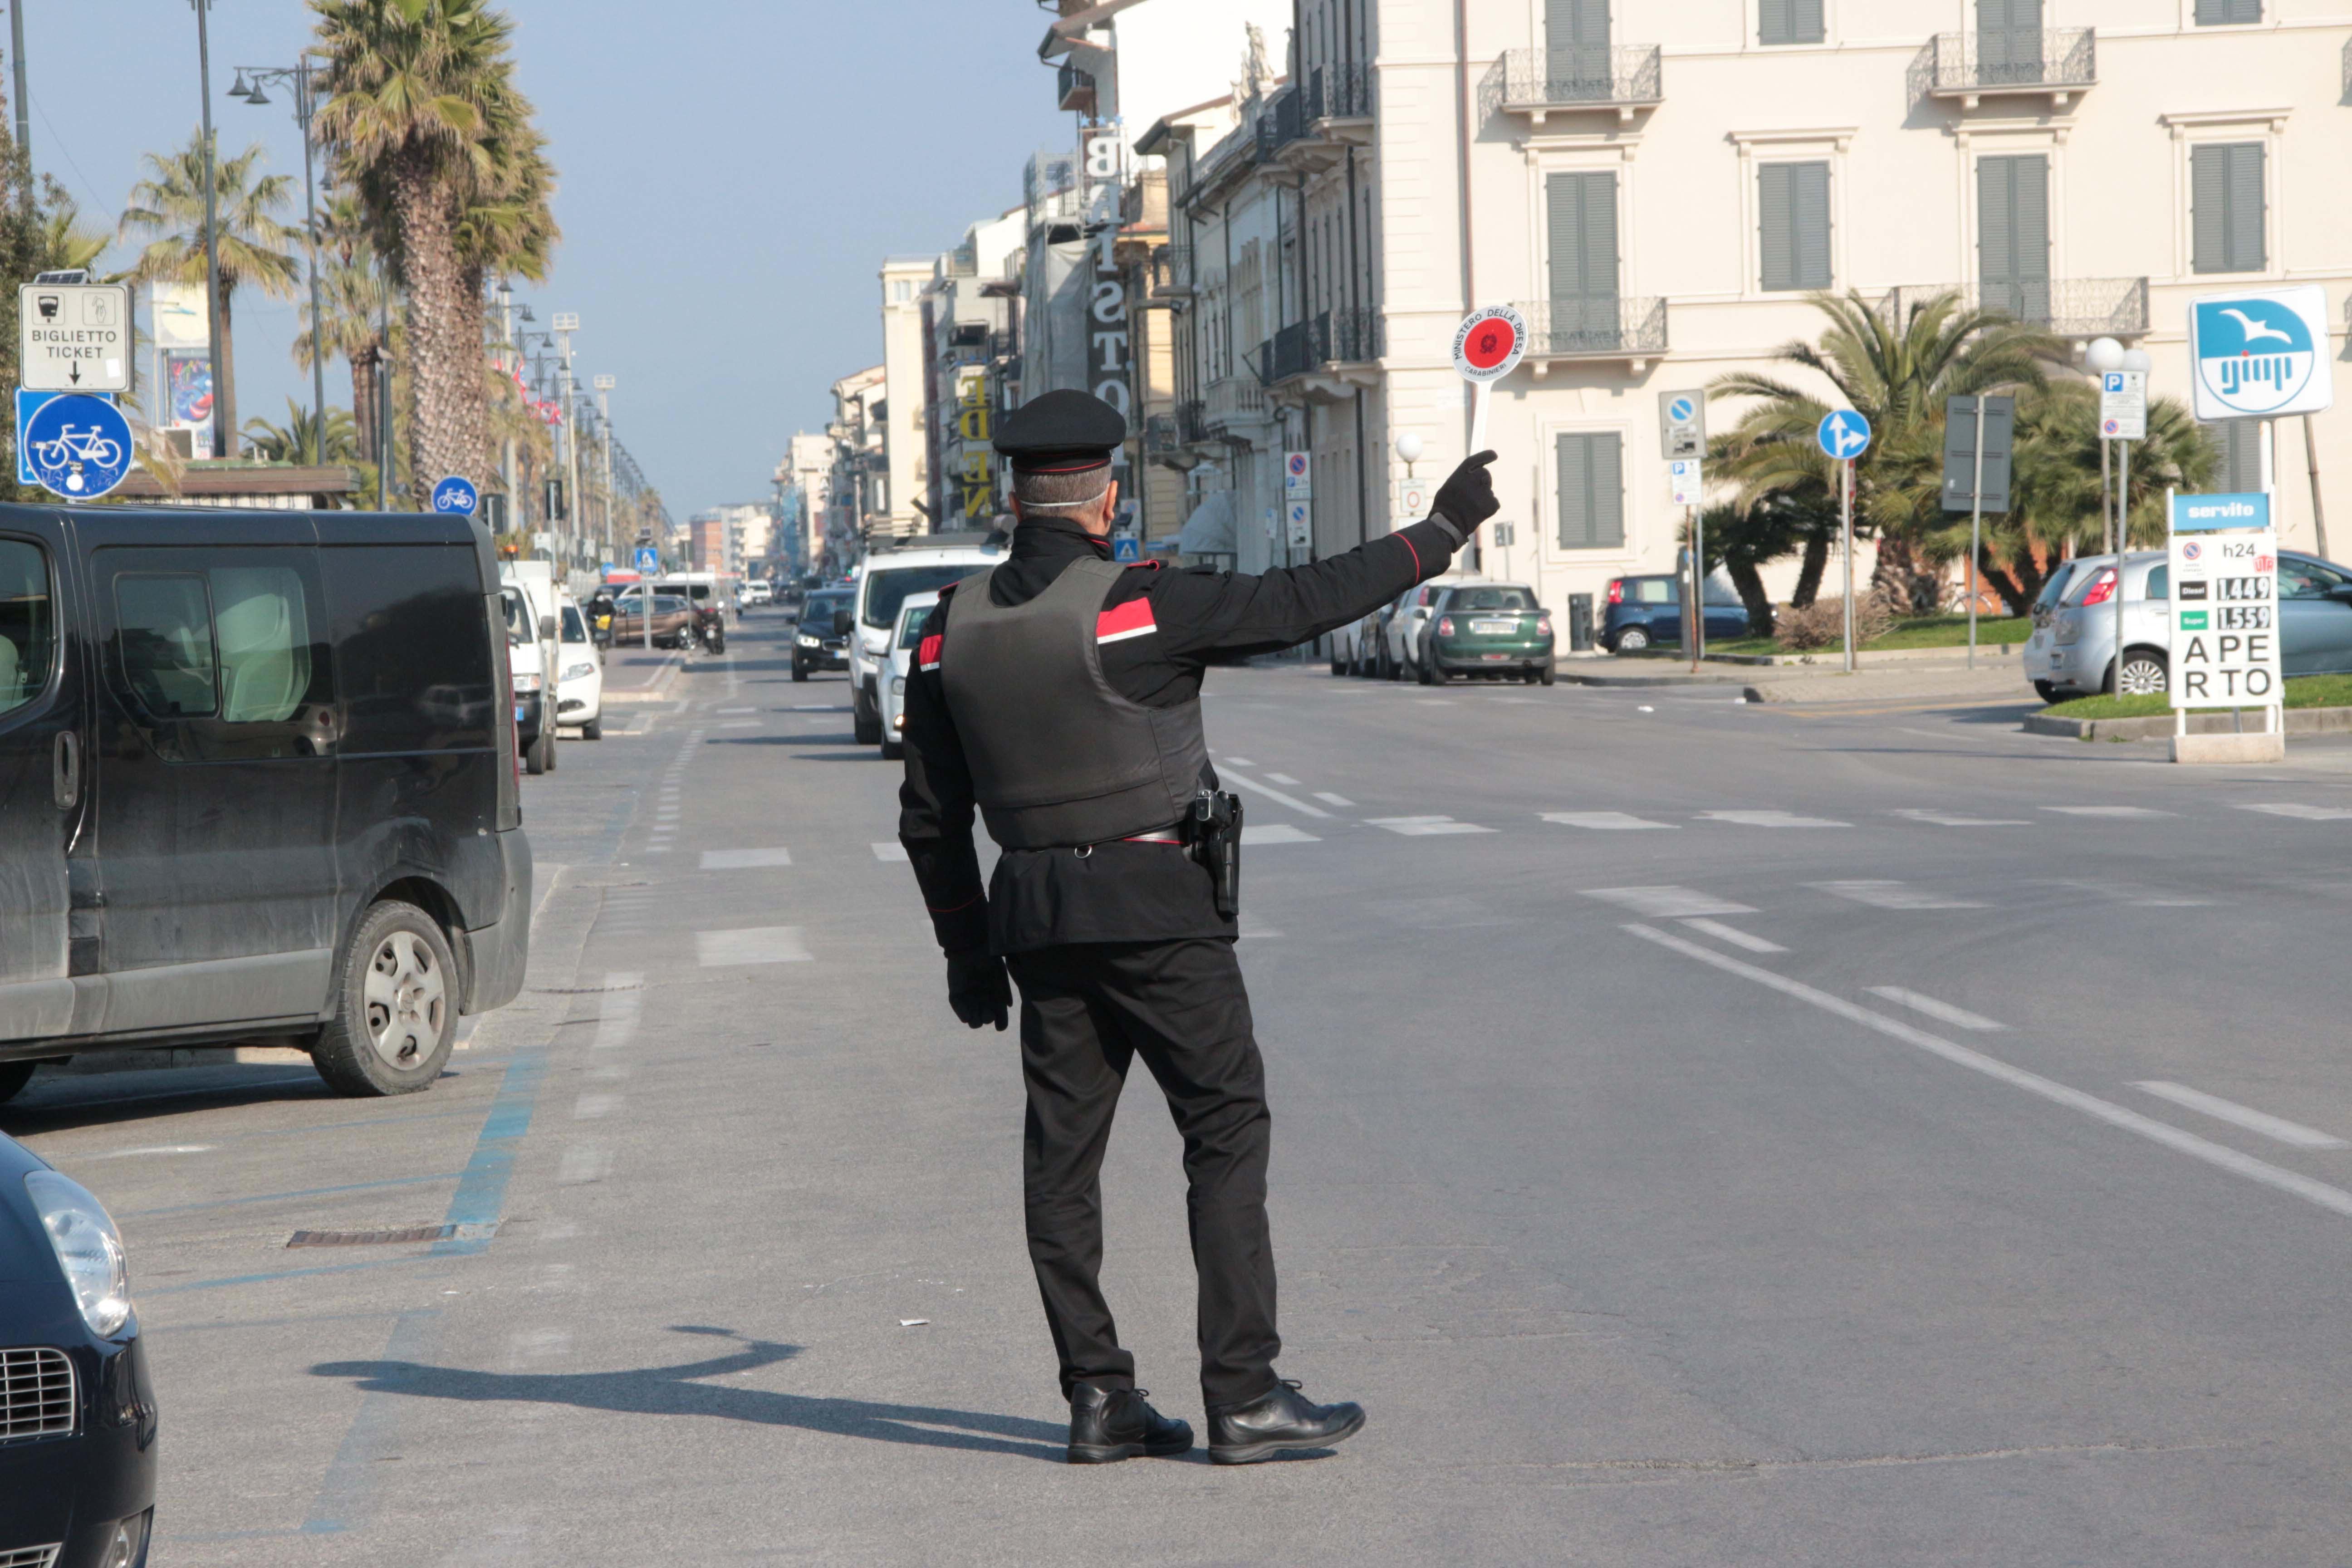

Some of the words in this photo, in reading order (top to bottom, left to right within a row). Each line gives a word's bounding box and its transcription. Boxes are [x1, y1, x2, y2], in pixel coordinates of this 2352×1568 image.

[32, 330, 116, 343] BIGLIETTO
[1454, 314, 1482, 360] MINISTERO
[1488, 309, 1515, 322] DELLA
[1512, 323, 1524, 355] DIFESA
[46, 347, 103, 358] TICKET
[1465, 363, 1507, 376] CARABINIERI
[2107, 375, 2120, 390] P
[1675, 463, 1684, 474] P
[2188, 502, 2254, 518] servito
[2223, 544, 2256, 558] h24
[2182, 587, 2205, 595] Diesel
[2219, 577, 2270, 601] 1,449
[2219, 607, 2270, 630] 1,559
[2184, 635, 2269, 663] APE
[2185, 668, 2272, 698] RTO
